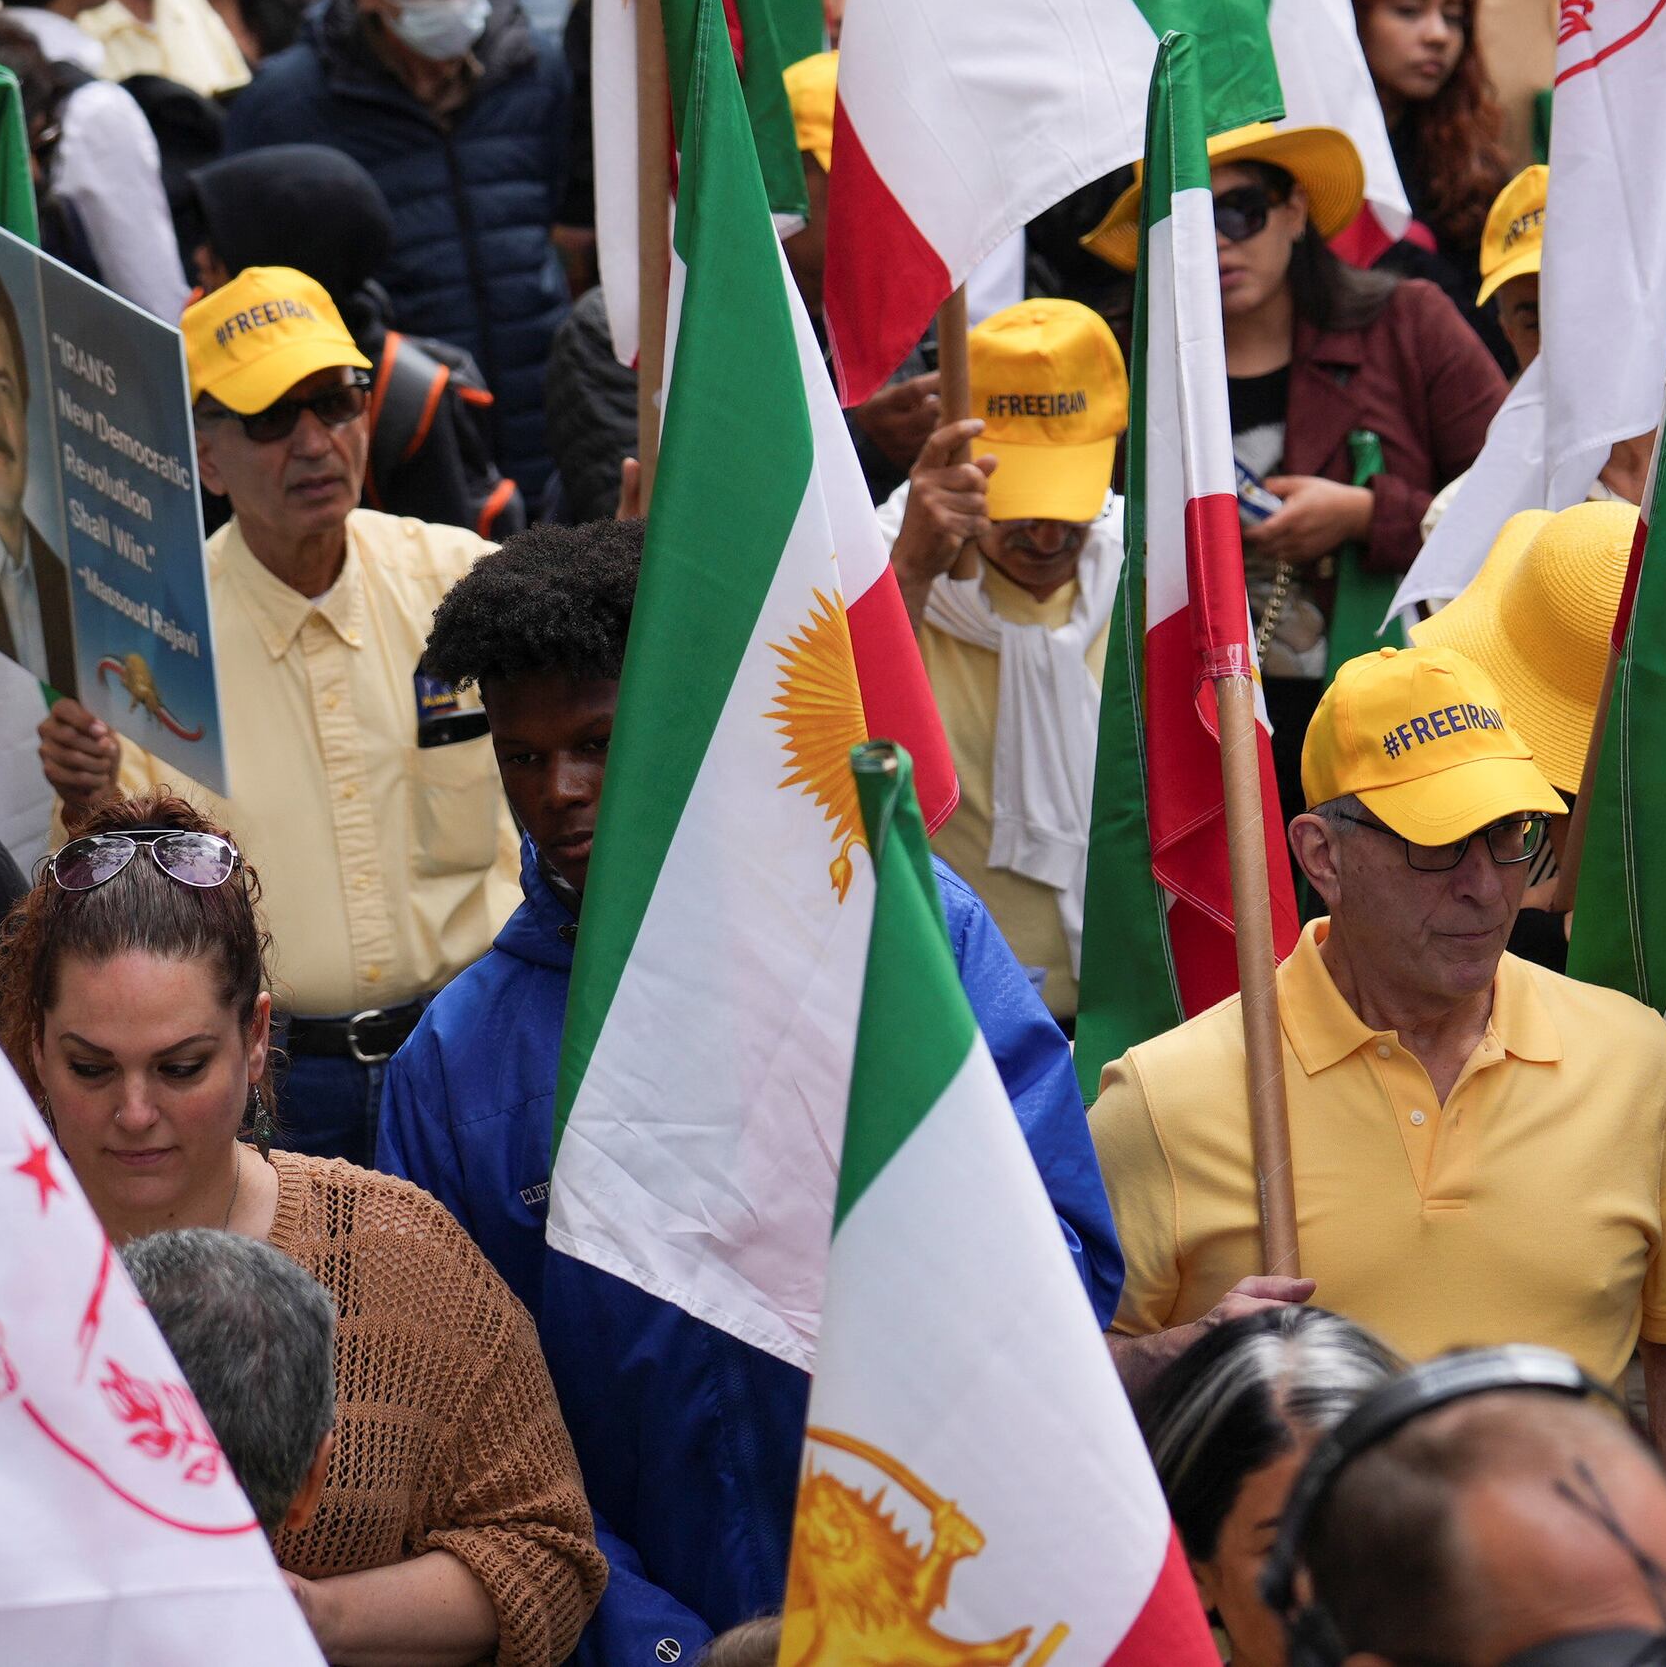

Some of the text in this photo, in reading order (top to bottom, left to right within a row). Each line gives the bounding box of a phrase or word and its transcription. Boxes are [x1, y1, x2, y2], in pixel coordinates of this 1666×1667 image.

[987, 390, 1088, 418] #FREEIRAN
[57, 388, 193, 492] New Democratic
[63, 443, 153, 522] Revolution
[69, 498, 113, 554] Shall
[151, 603, 200, 659] Rajavi
[1382, 702, 1506, 760] #FREEIRAN
